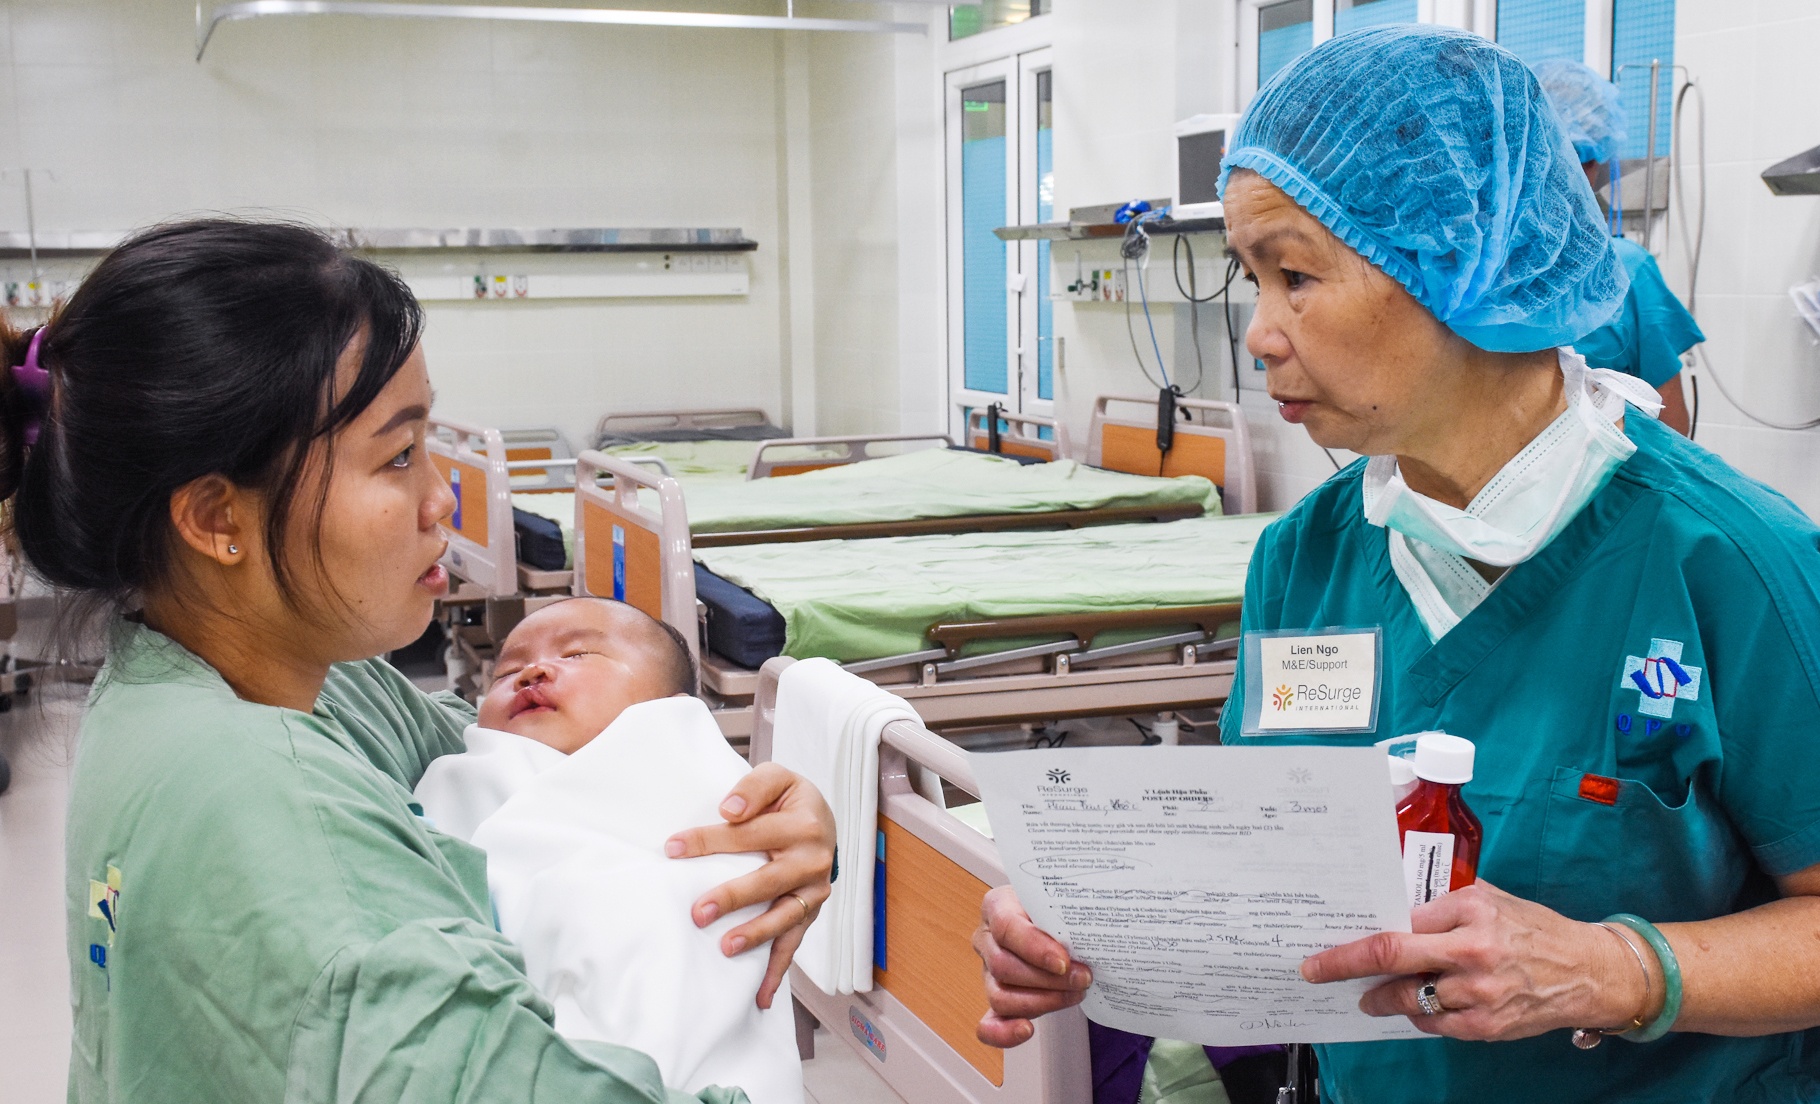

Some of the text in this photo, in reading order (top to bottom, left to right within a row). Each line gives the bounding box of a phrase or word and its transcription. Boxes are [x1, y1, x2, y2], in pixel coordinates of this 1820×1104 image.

[1290, 644, 1339, 656] Lien Ngo
[1282, 660, 1348, 671] M&E/Support
[1297, 684, 1361, 703] ReSurge
[1036, 785, 1088, 794] ReSurge
[1290, 801, 1302, 813] 3
[1272, 934, 1283, 947] 4
